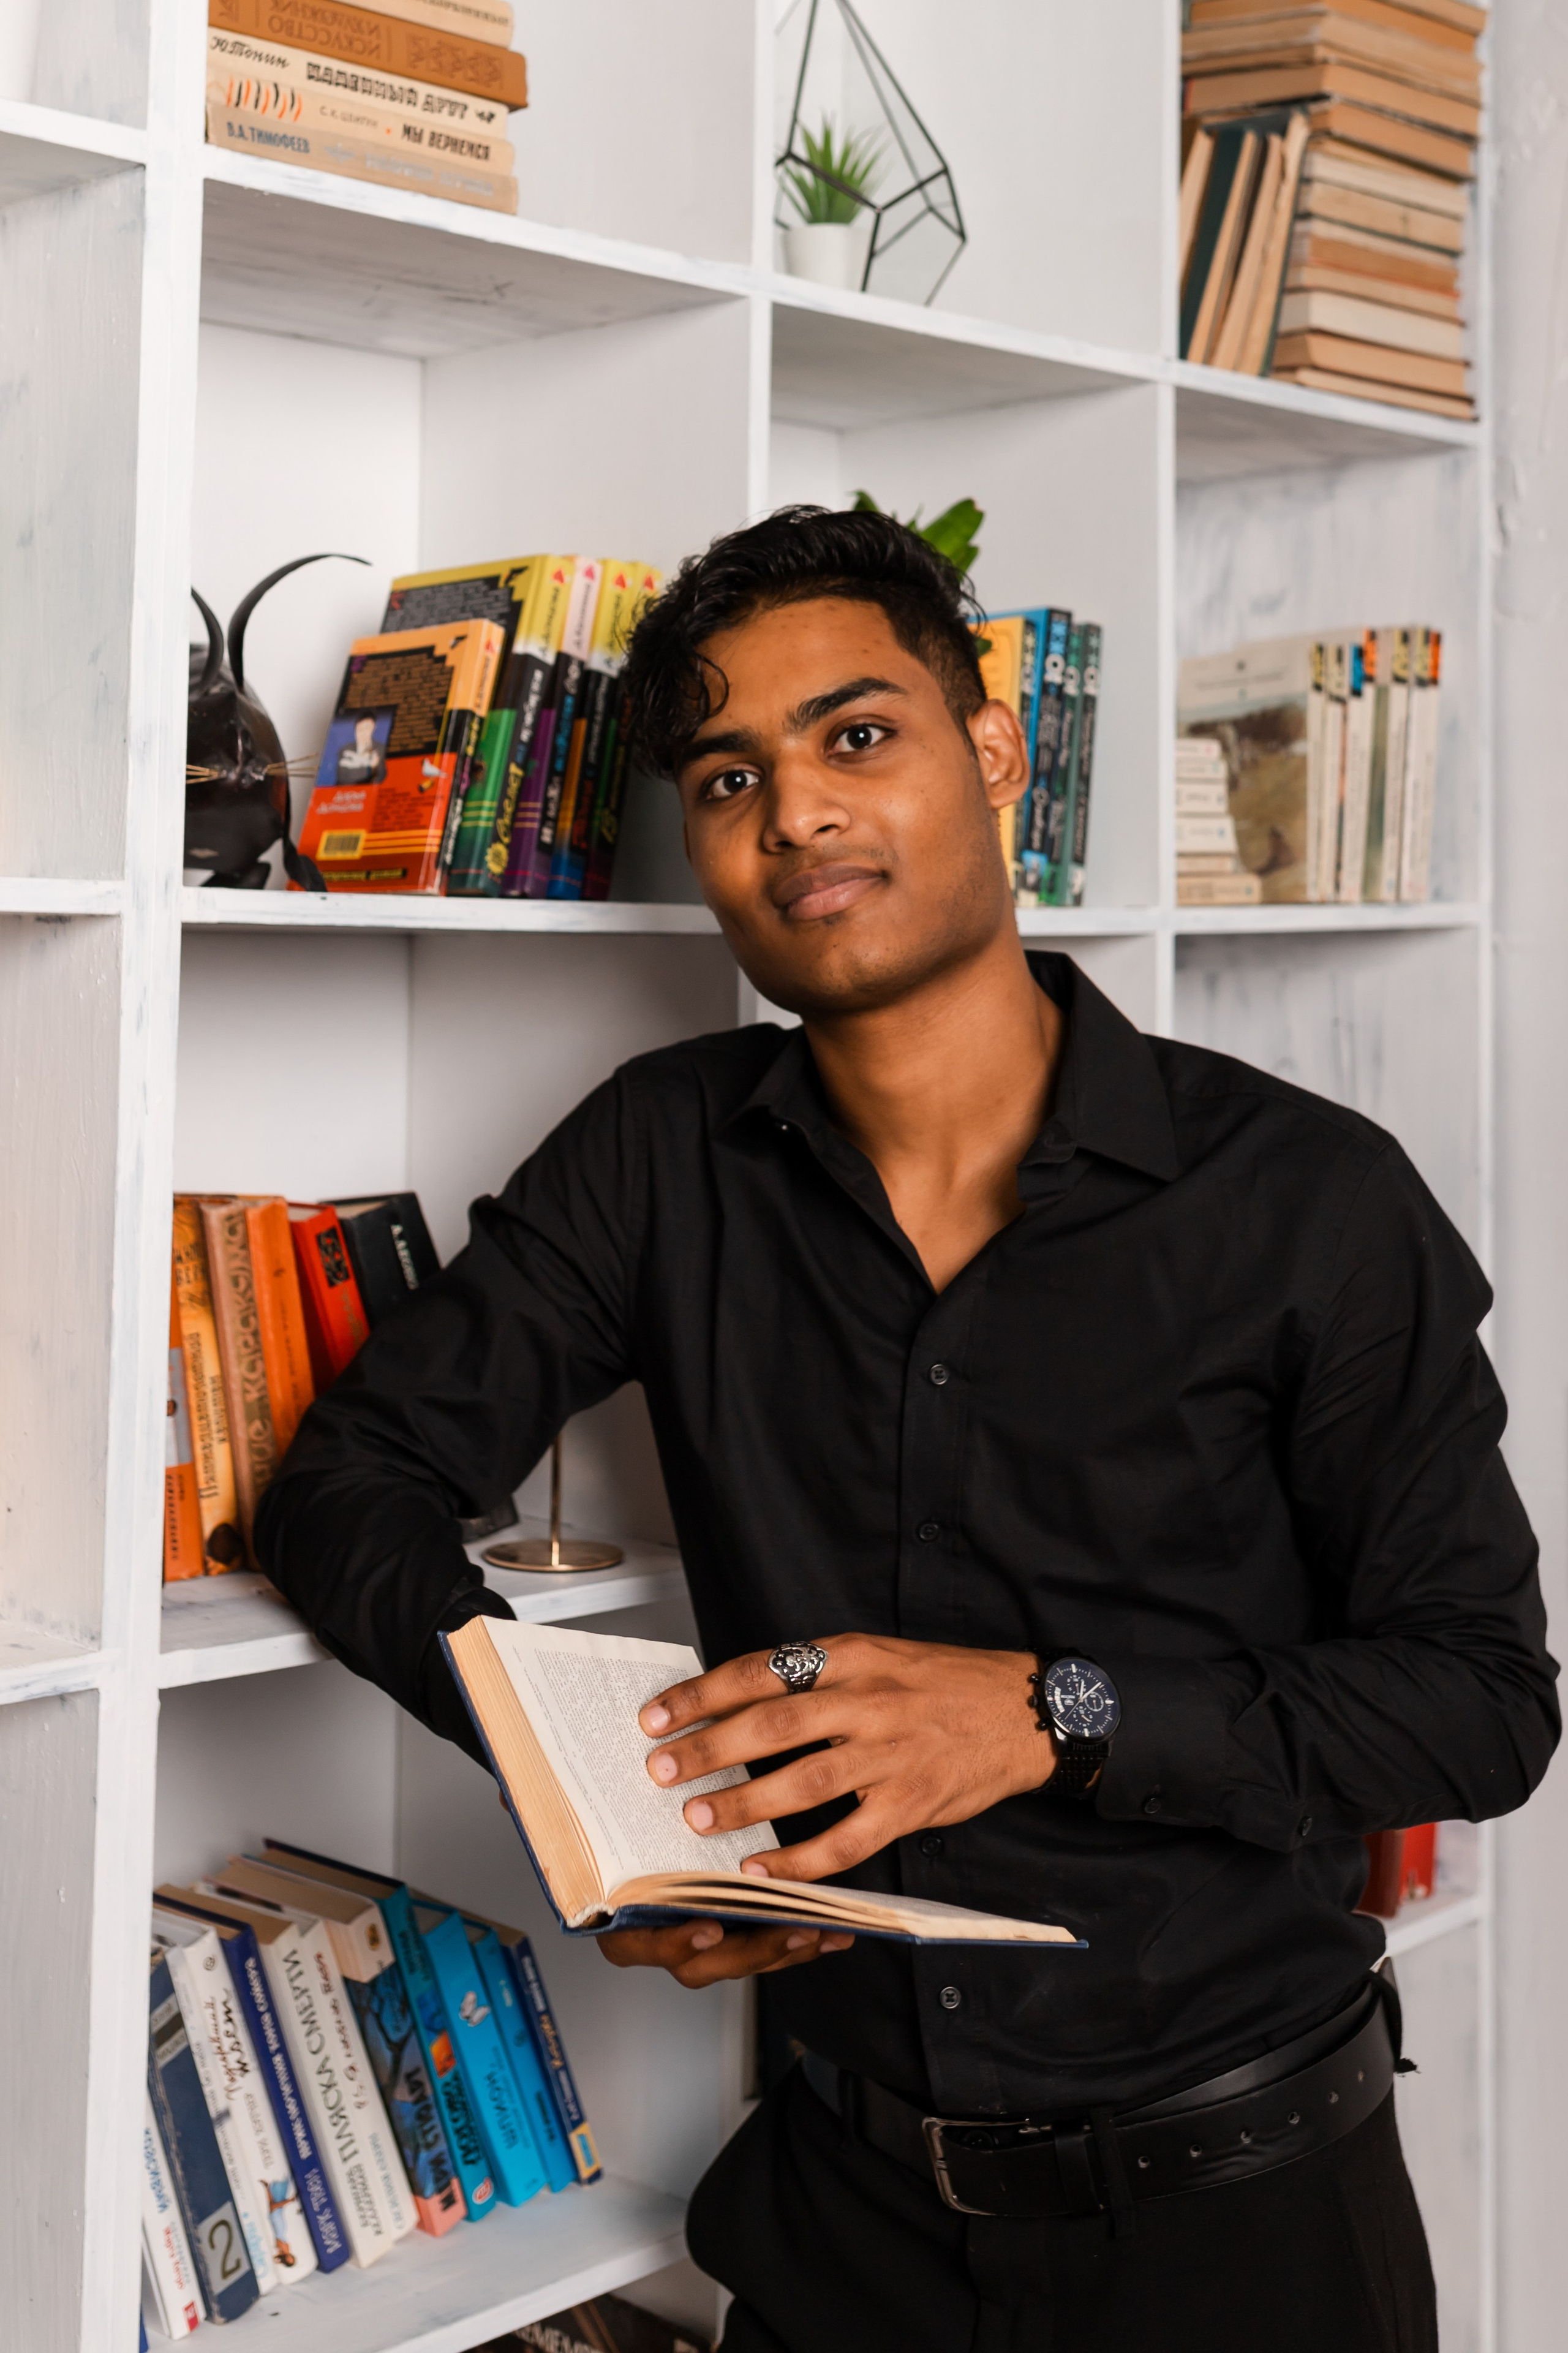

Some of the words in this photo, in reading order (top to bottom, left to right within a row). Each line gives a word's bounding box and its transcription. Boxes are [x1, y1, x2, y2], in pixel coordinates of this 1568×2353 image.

[268, 13, 381, 60] ИСКУССТВО
[401, 123, 423, 145] МЫ
[429, 130, 491, 161] ВЕРНЕМСЯ
[281, 1948, 325, 2057] СМЕРТИ
[311, 2053, 361, 2165] ПЛЯСКА
[202, 2216, 243, 2280] 2
